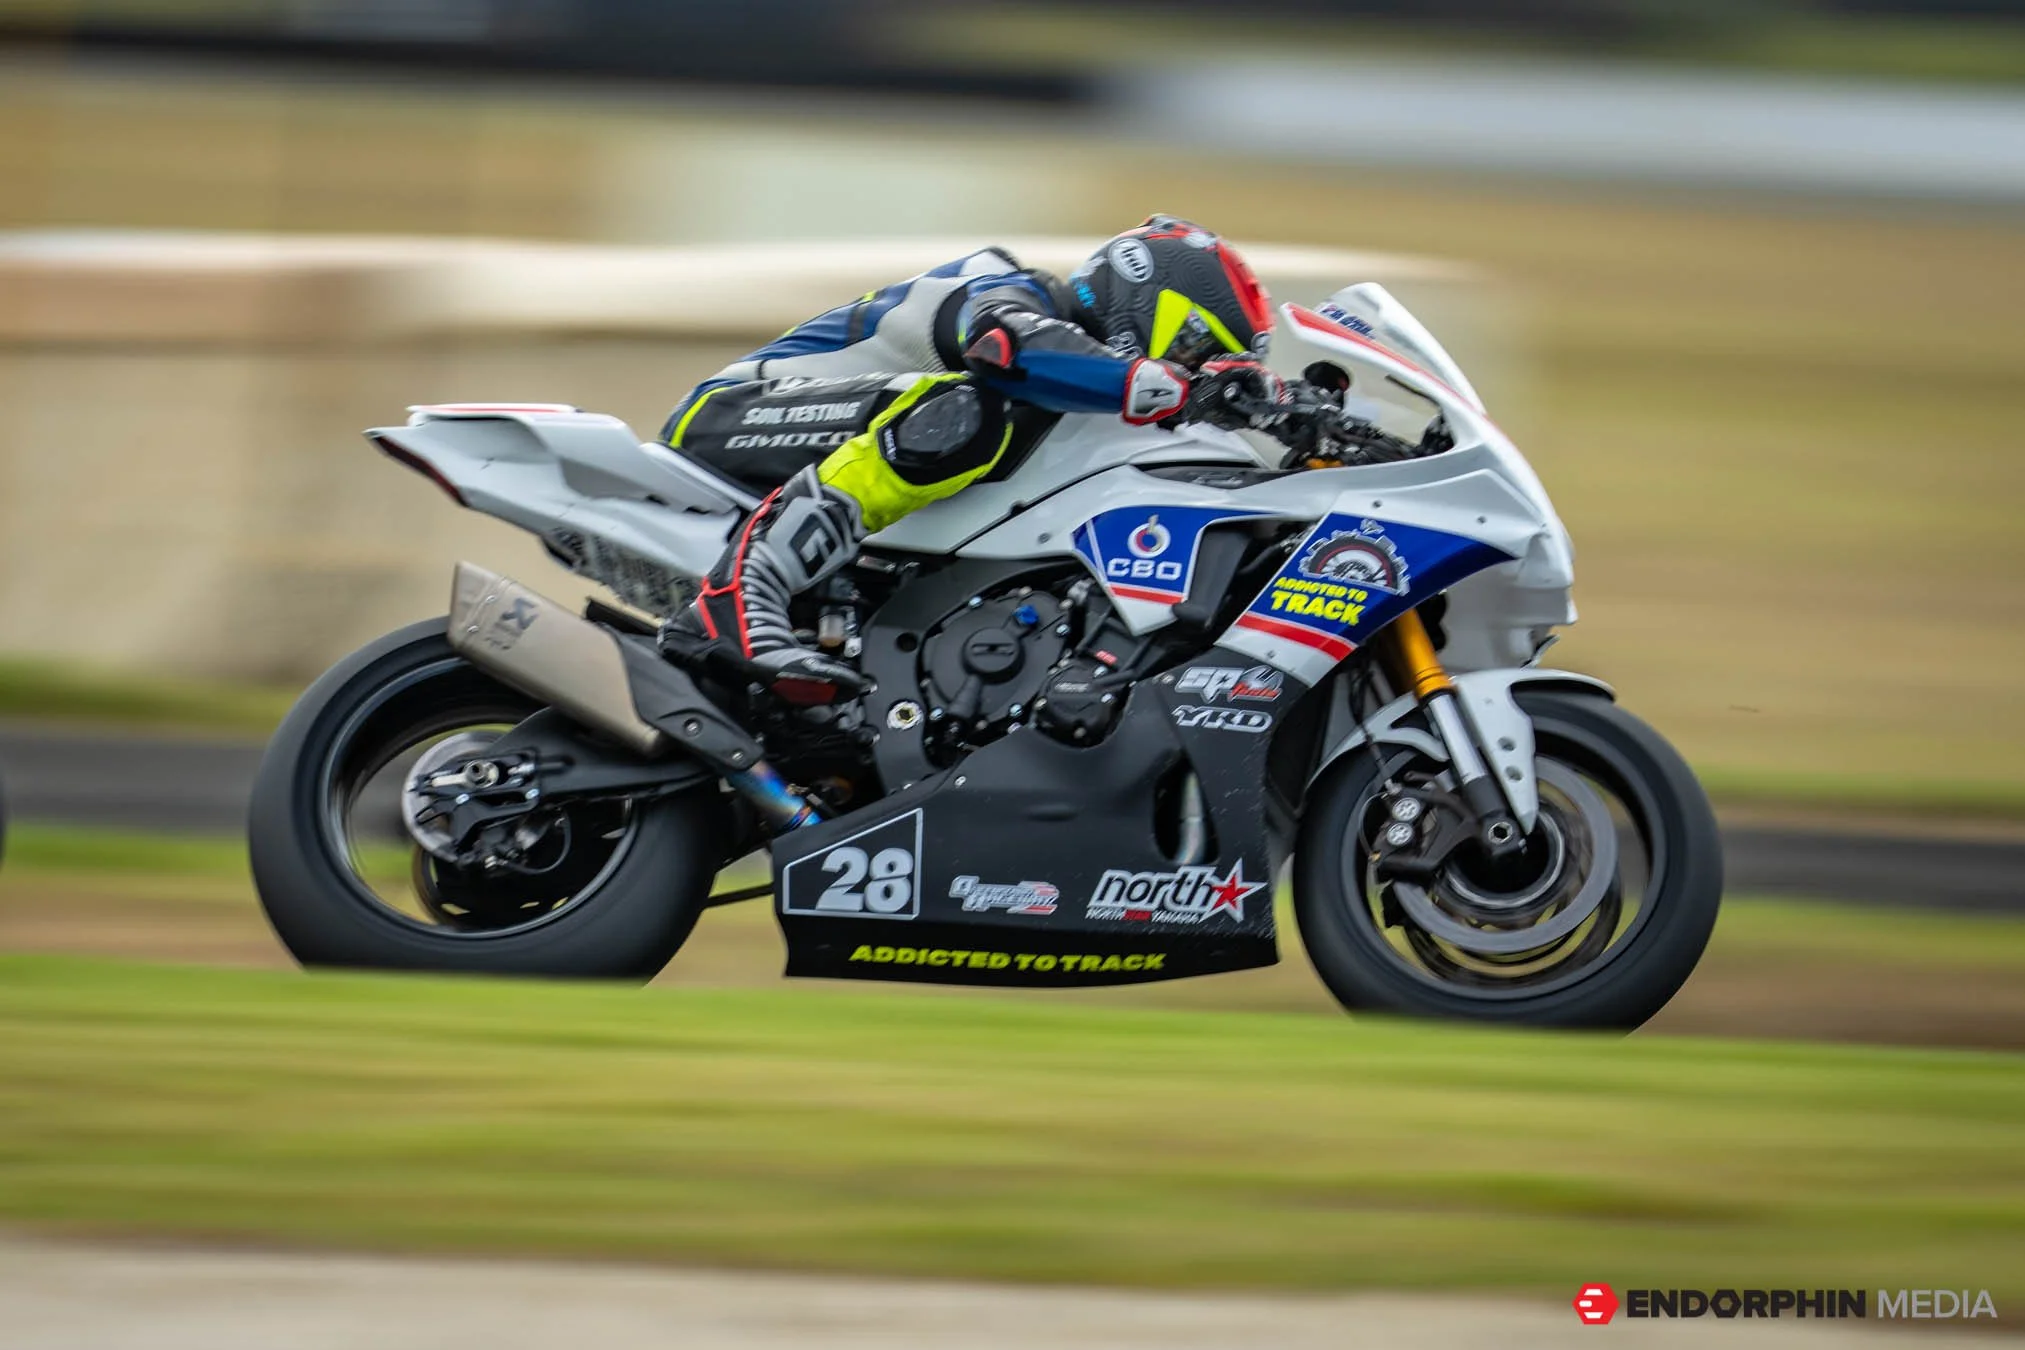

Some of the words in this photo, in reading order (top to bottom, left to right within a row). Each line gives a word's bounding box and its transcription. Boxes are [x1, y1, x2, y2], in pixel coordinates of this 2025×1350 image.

[784, 402, 862, 424] TESTING
[1107, 557, 1182, 580] CBO
[1273, 577, 1348, 597] ADDICTED
[1347, 588, 1368, 602] TO
[1271, 590, 1366, 626] TRACK
[815, 846, 913, 914] 28
[1091, 867, 1215, 910] north
[849, 945, 1011, 969] ADDICTED
[1014, 953, 1058, 971] TO
[1059, 953, 1167, 972] TRACK
